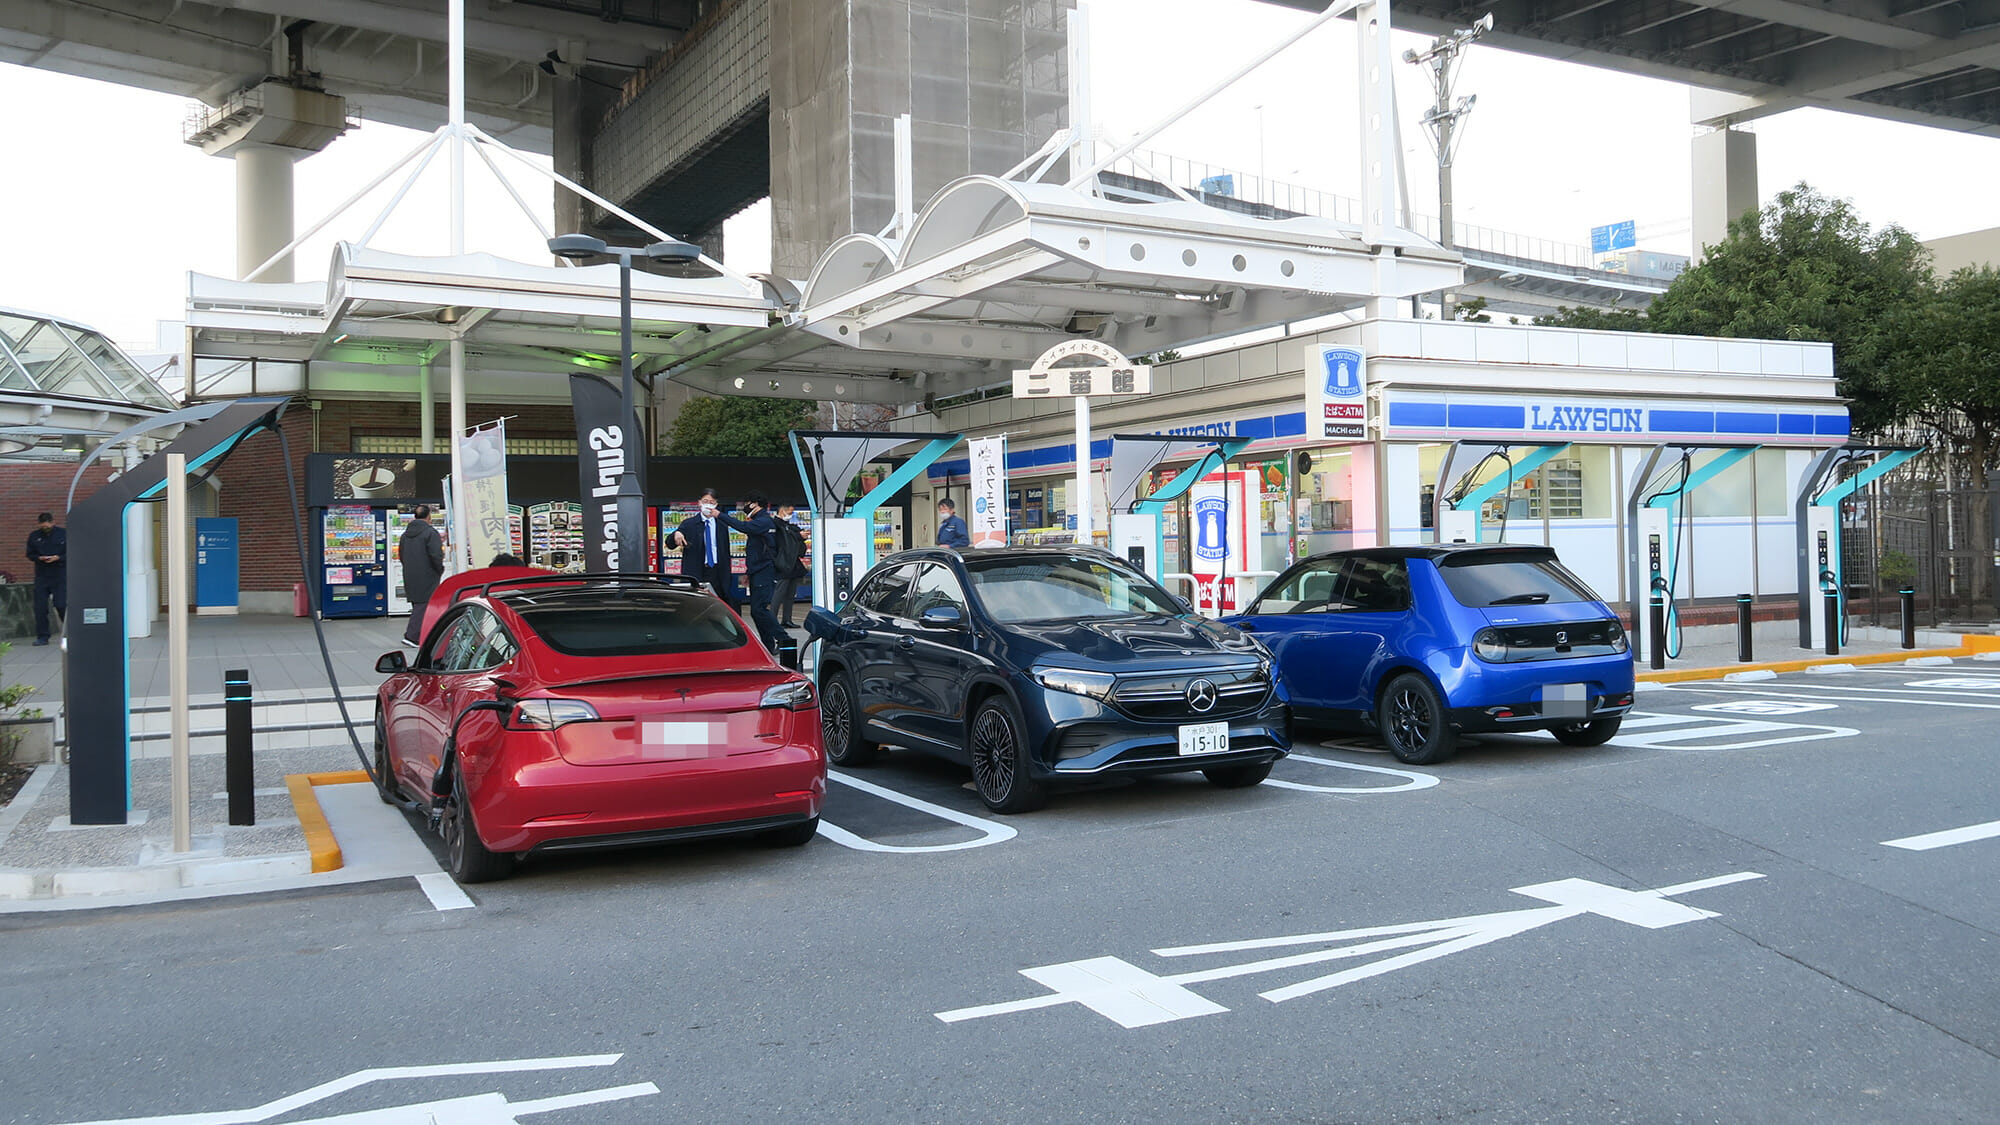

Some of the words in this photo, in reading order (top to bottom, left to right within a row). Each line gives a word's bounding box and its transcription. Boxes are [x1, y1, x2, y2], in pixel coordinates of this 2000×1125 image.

[1041, 343, 1119, 366] ベイサイドテラス
[1327, 352, 1358, 363] LAWSON
[1027, 368, 1135, 395] 二番館
[1327, 385, 1359, 396] STATION
[1532, 405, 1643, 433] LAWSON
[1145, 421, 1231, 447] SON
[1325, 426, 1348, 435] MACHI
[1206, 724, 1217, 735] 301
[1193, 734, 1226, 752] 15-10
